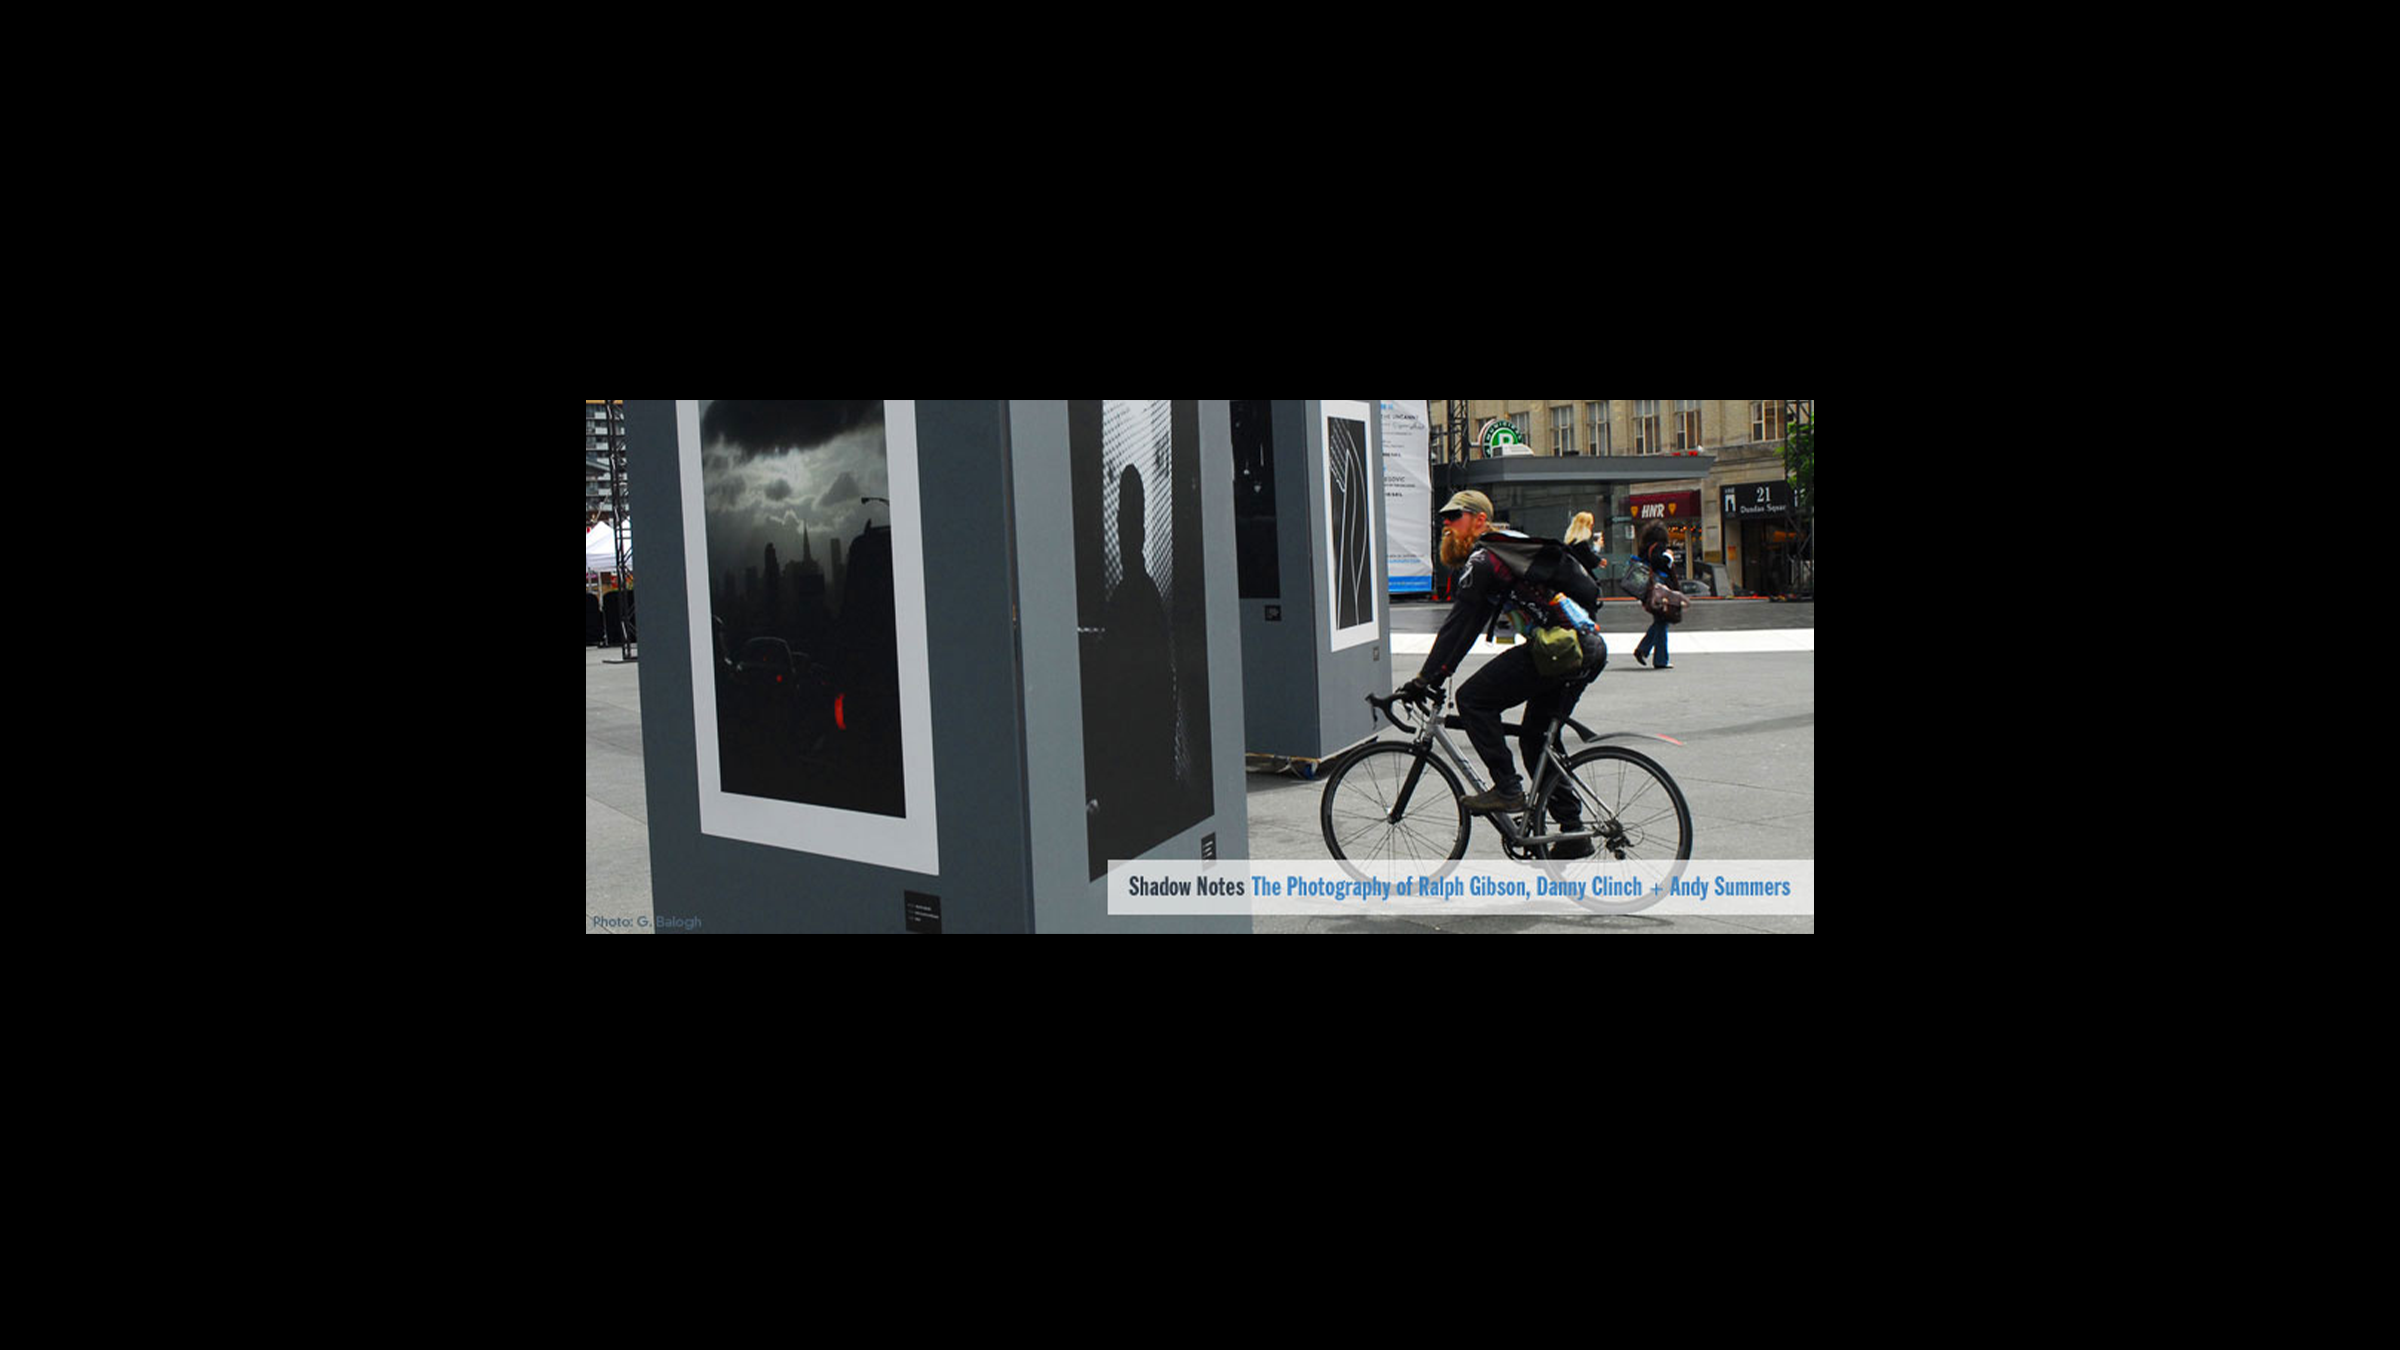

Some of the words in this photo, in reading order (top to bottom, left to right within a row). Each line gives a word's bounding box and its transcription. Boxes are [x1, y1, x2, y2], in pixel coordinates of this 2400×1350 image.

[1499, 433, 1513, 446] P
[1757, 486, 1771, 502] 21
[1641, 503, 1665, 519] HNR
[1740, 505, 1765, 514] Dundas
[1766, 503, 1787, 513] Squar
